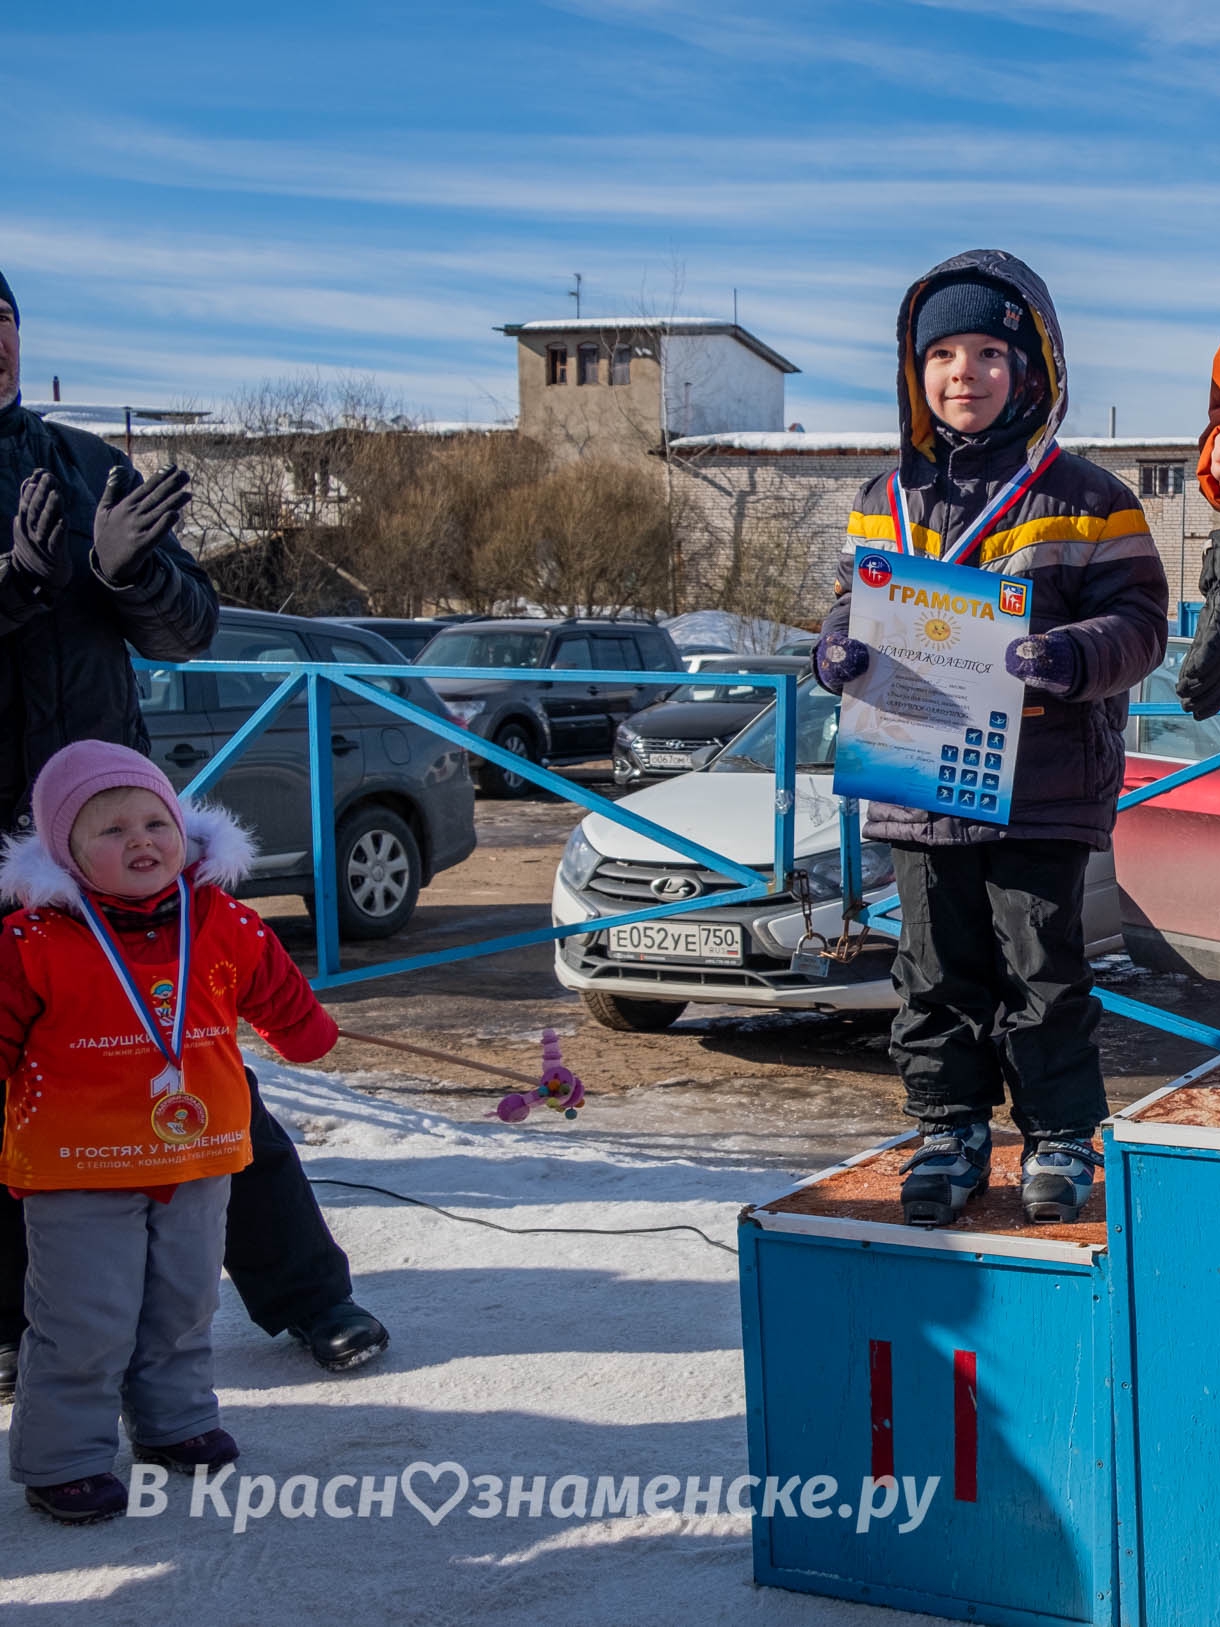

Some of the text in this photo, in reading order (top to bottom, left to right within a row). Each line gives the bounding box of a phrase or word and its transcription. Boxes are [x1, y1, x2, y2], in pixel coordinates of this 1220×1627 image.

[888, 583, 996, 621] ГРАМОТА
[878, 645, 994, 674] НАГРАЖДАЕТСЯ
[616, 926, 735, 952] Е052УЕ 750
[60, 1147, 71, 1158] В
[75, 1144, 144, 1158] ГОСТЯХ
[150, 1143, 159, 1155] У
[1047, 1141, 1091, 1155] Spine
[77, 1161, 85, 1169] С
[138, 1156, 186, 1167] КОМАНДА
